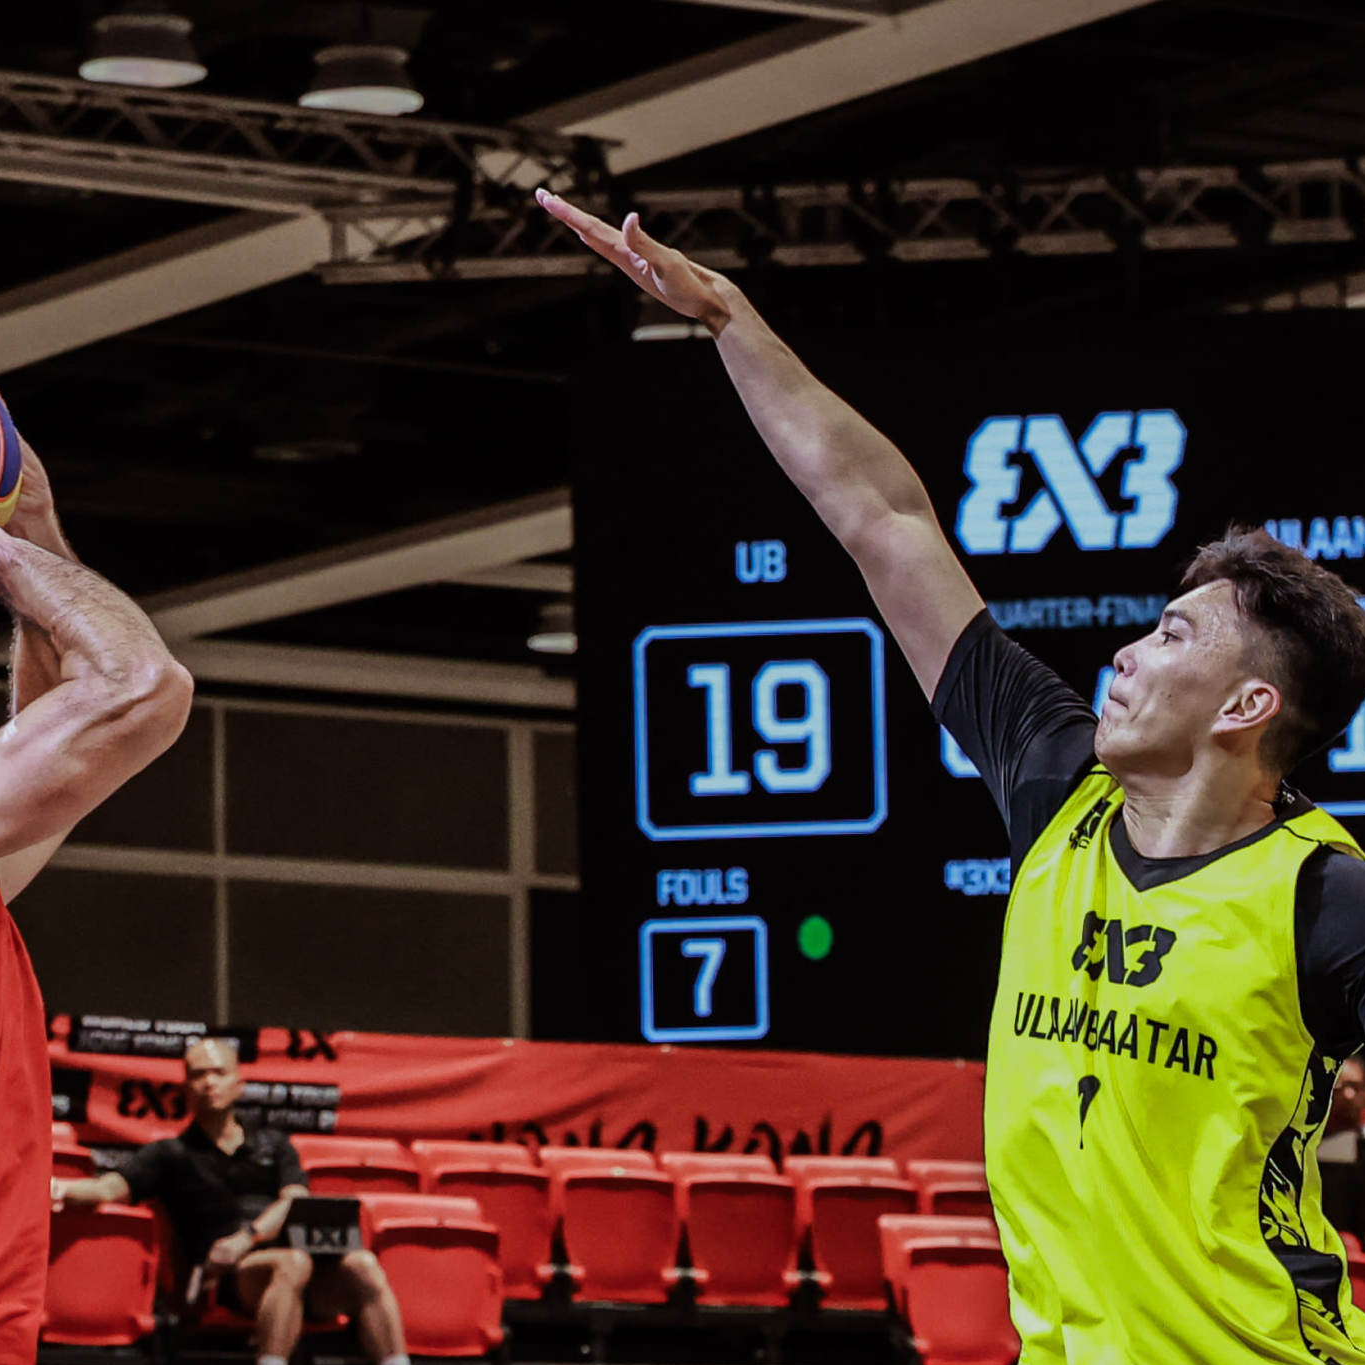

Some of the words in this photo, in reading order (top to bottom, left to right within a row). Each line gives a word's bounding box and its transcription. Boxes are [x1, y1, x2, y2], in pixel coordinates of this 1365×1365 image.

[955, 408, 1188, 556] 3X3
[734, 539, 787, 584] UB
[686, 658, 833, 797] 19
[656, 866, 750, 907] FOULS
[680, 937, 728, 1019] 7
